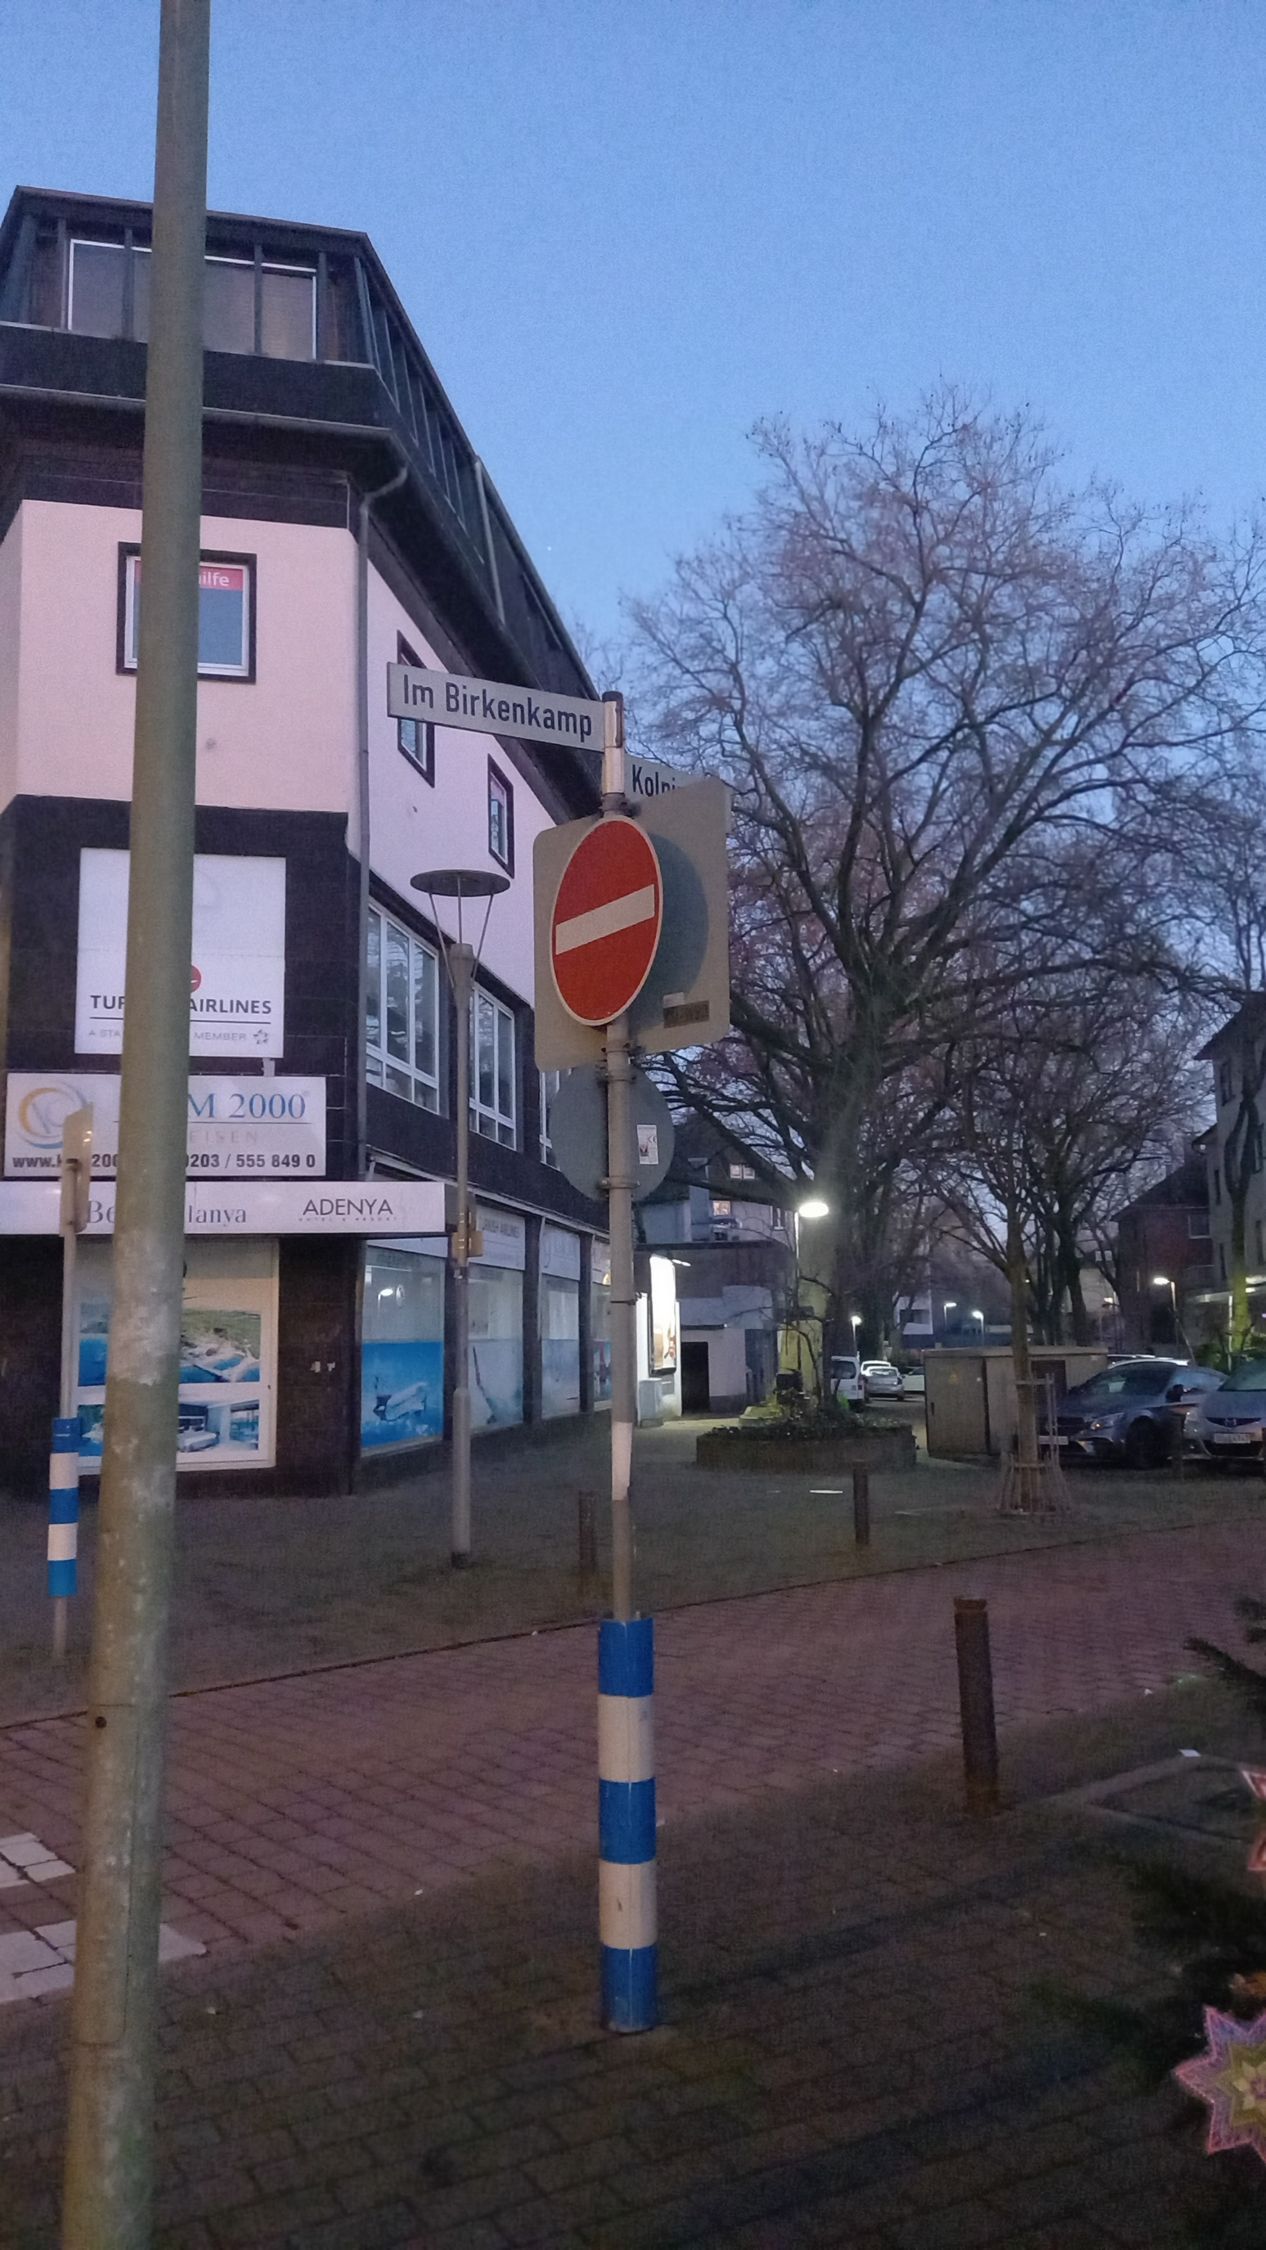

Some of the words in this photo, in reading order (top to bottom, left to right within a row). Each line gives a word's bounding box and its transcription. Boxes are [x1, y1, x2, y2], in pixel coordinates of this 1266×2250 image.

[198, 571, 230, 587] ilfe
[403, 674, 434, 709] Im
[445, 682, 593, 743] Birkenkamp
[190, 998, 272, 1015] AIRLINES
[194, 1031, 247, 1042] MEMBER
[228, 1093, 306, 1120] 2000
[189, 1130, 257, 1144] EISEN
[236, 1153, 266, 1169] 555
[271, 1153, 301, 1169] 849
[305, 1153, 316, 1169] 0
[187, 1205, 247, 1228] lanya
[302, 1199, 394, 1216] ADENYA
